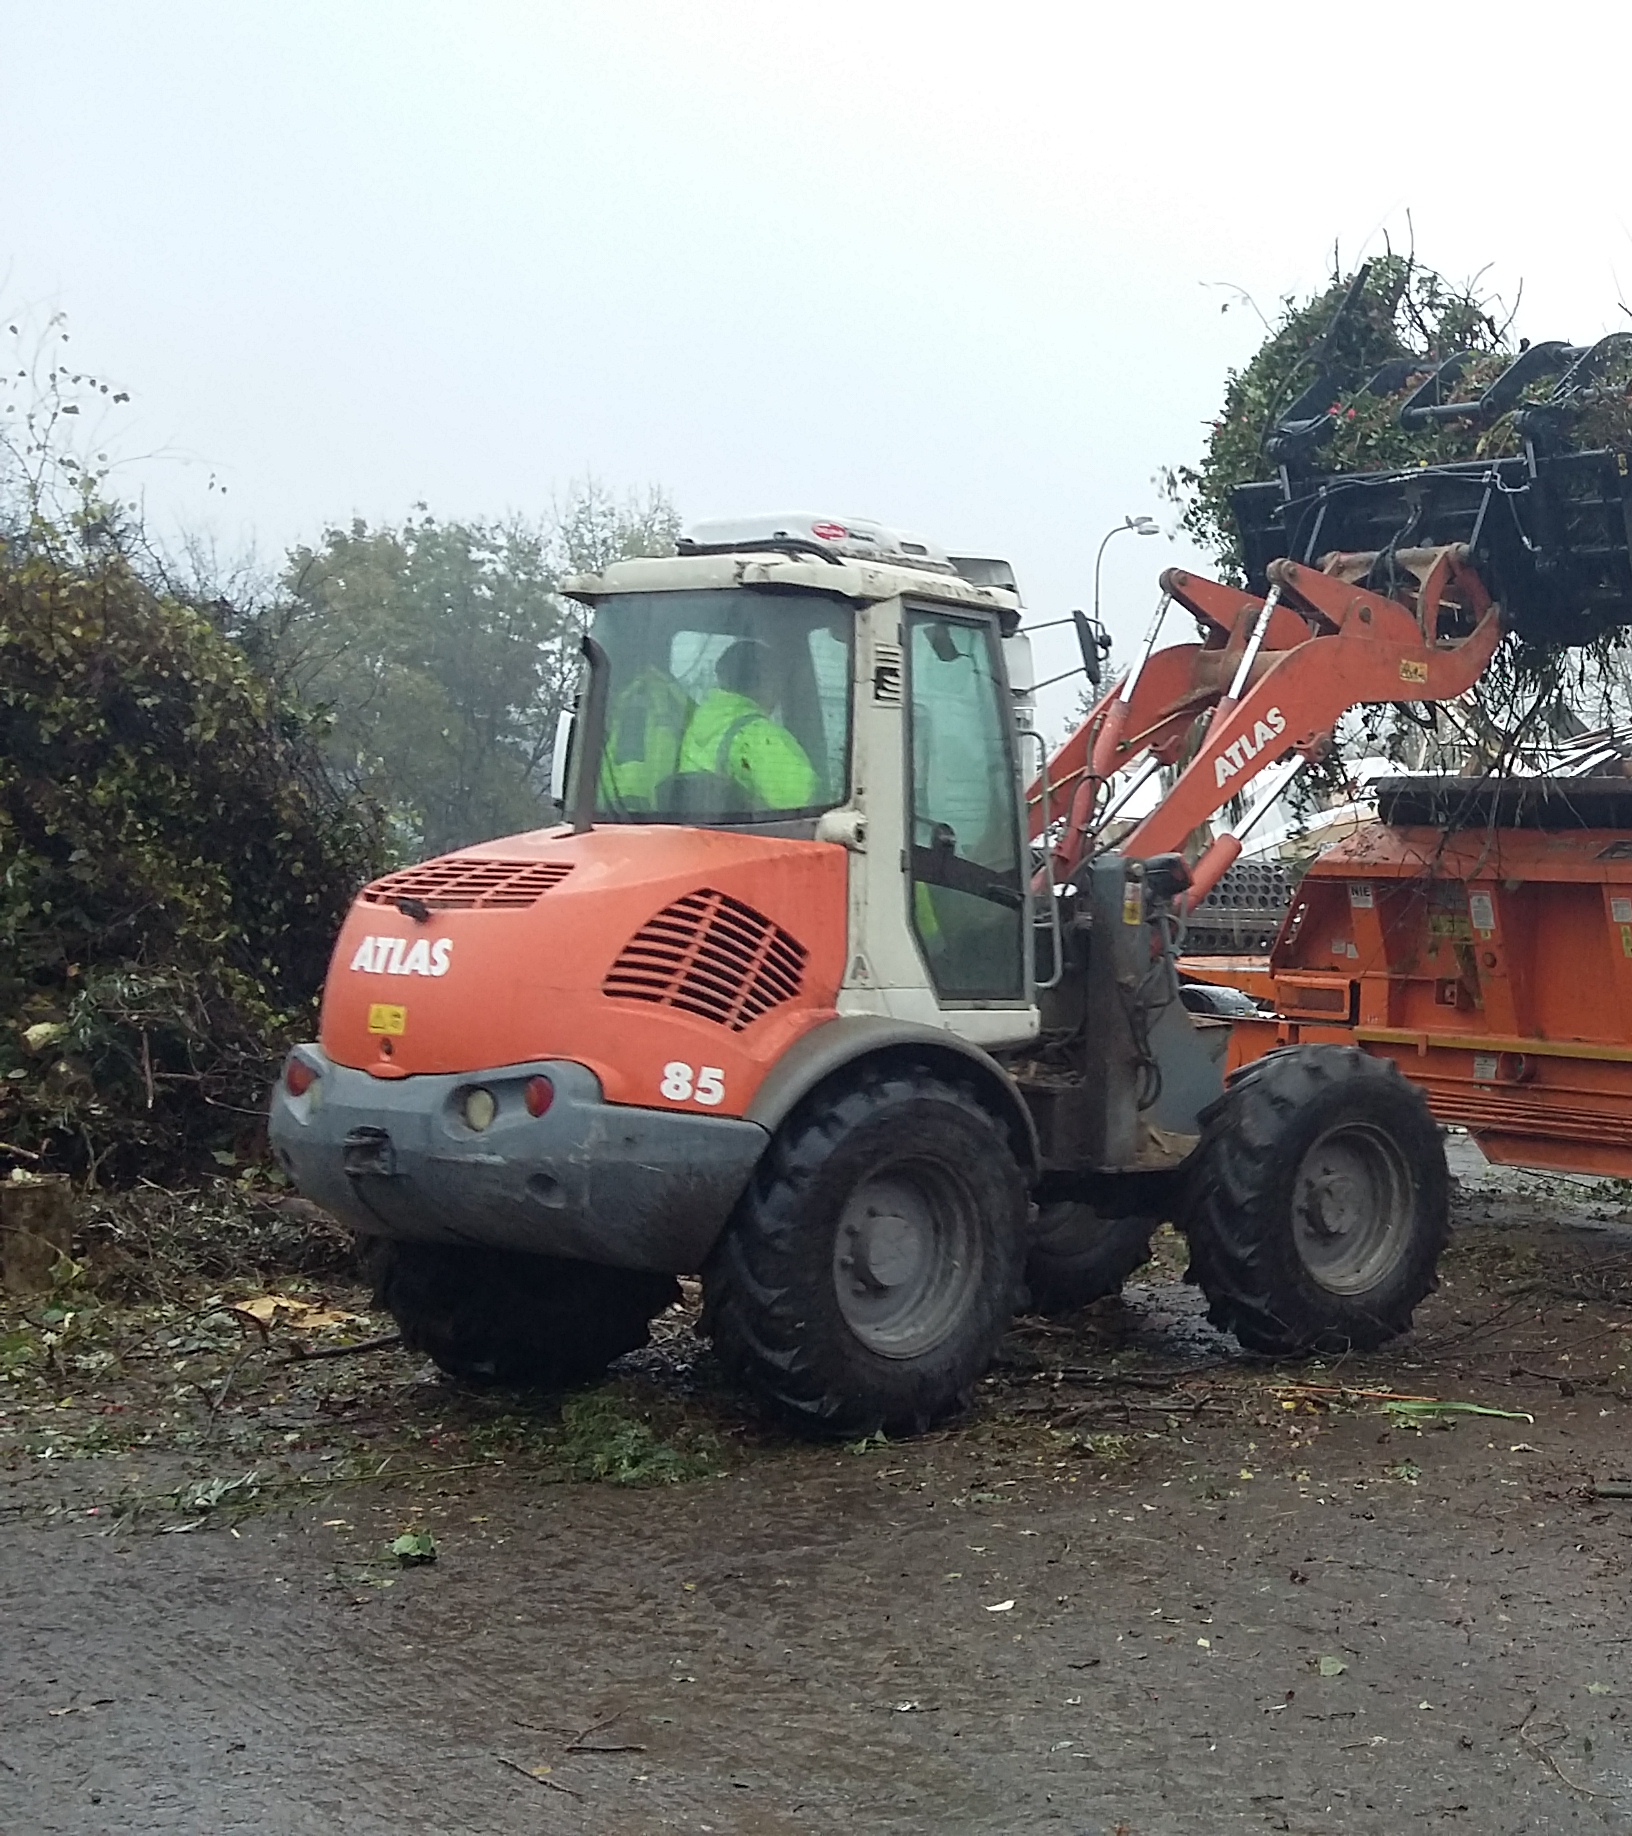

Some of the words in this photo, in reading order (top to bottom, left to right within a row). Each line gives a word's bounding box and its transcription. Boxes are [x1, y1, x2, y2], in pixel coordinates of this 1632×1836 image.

[1214, 707, 1286, 788] ATLAS
[1351, 885, 1371, 897] NIE
[350, 936, 454, 977] ATLAS
[660, 1061, 726, 1106] 85
